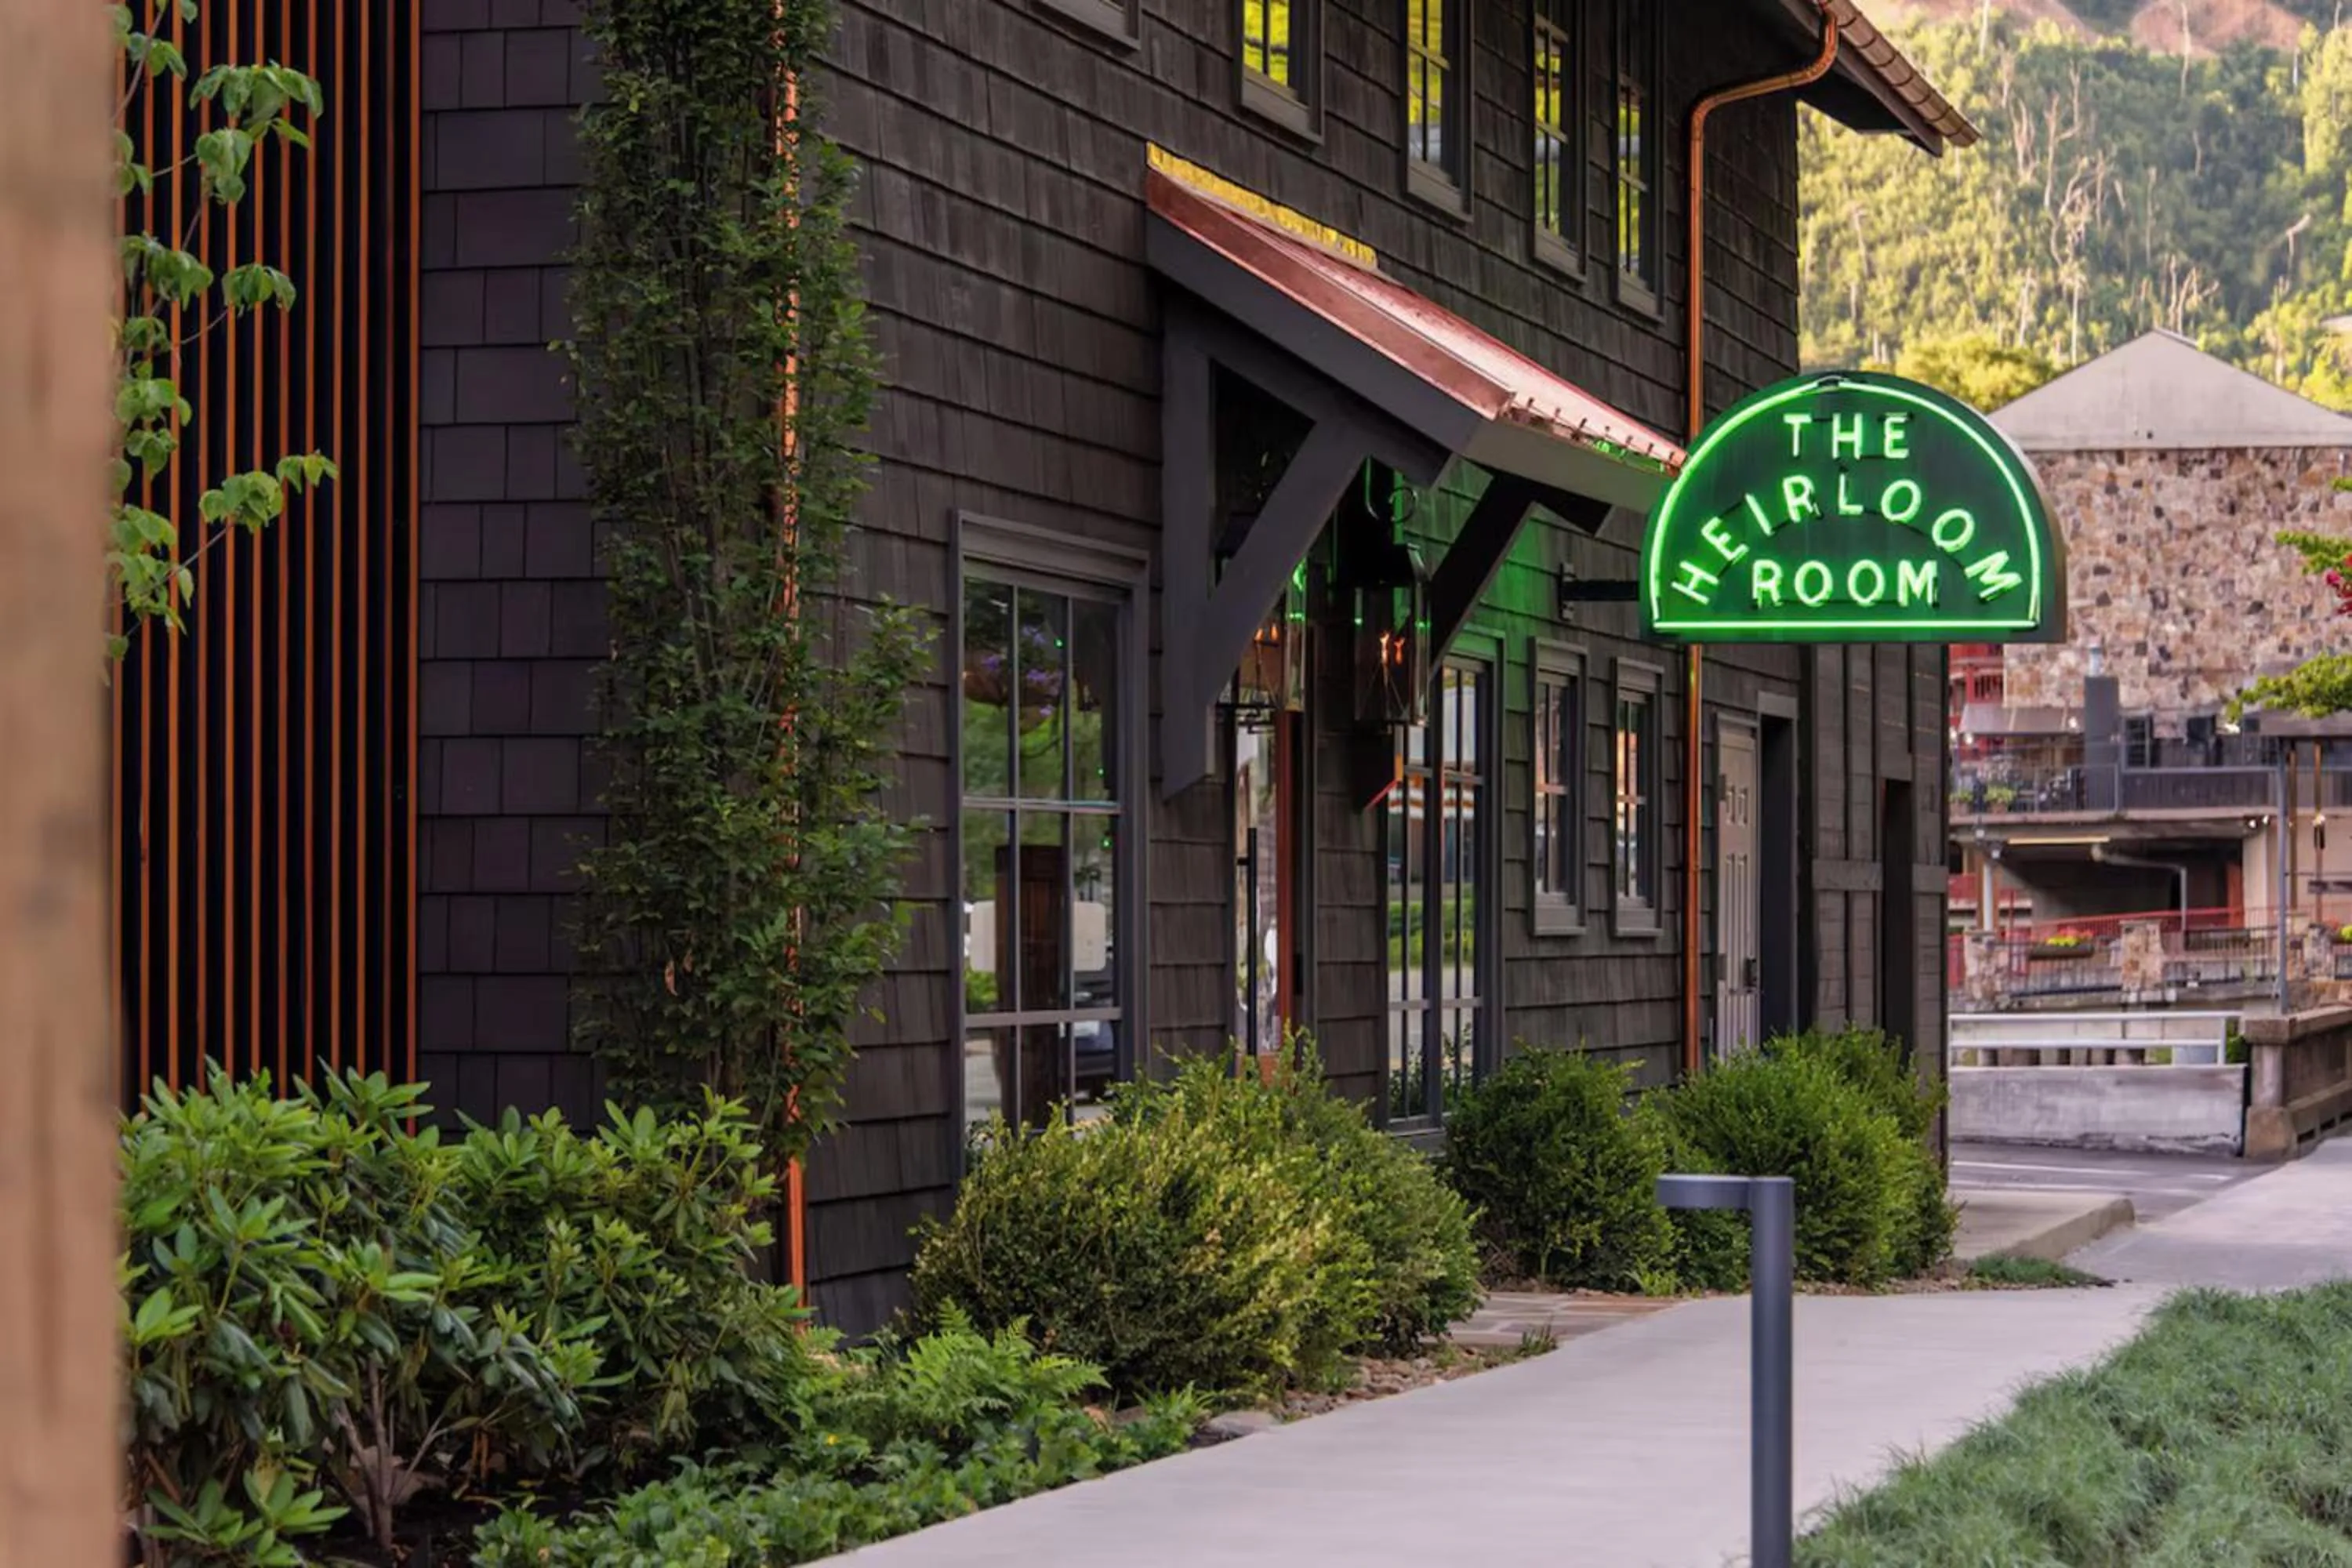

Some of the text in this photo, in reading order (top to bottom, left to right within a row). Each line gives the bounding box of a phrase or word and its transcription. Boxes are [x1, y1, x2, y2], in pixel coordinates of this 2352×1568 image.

[1784, 412, 1910, 460] THE
[1671, 474, 2023, 605] HEIRLOOM
[1752, 559, 1939, 608] ROOM
